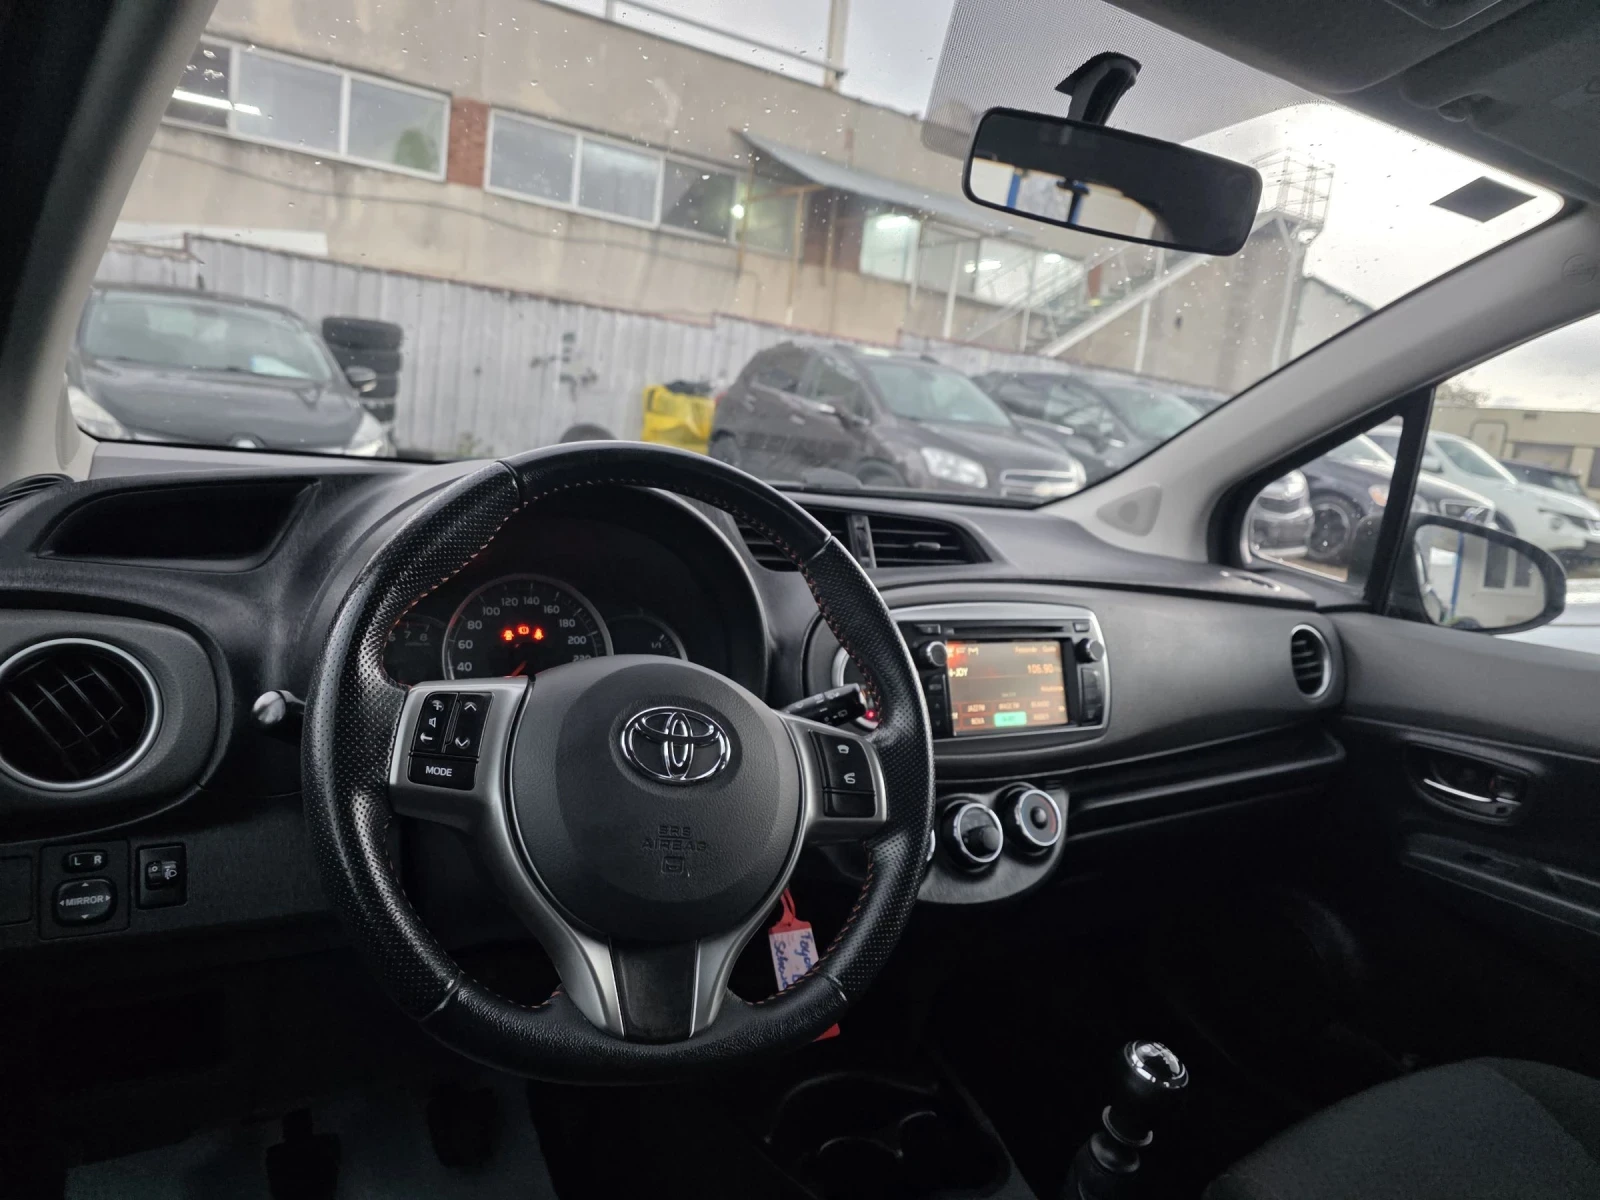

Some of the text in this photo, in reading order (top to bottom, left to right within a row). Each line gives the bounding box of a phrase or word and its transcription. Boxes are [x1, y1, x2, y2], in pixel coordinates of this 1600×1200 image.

[501, 597, 519, 607] 120
[523, 596, 541, 605] 140
[482, 606, 501, 616] 100
[543, 605, 560, 614] 160
[467, 620, 483, 630] 80
[559, 618, 576, 628] 180
[457, 640, 474, 650] 60
[567, 635, 587, 645] 200
[456, 661, 473, 672] 40
[425, 765, 453, 778] MODE
[658, 825, 692, 837] SRS
[641, 838, 707, 851] AIRBAG
[74, 855, 102, 866] L R
[65, 895, 104, 906] MIRROR
